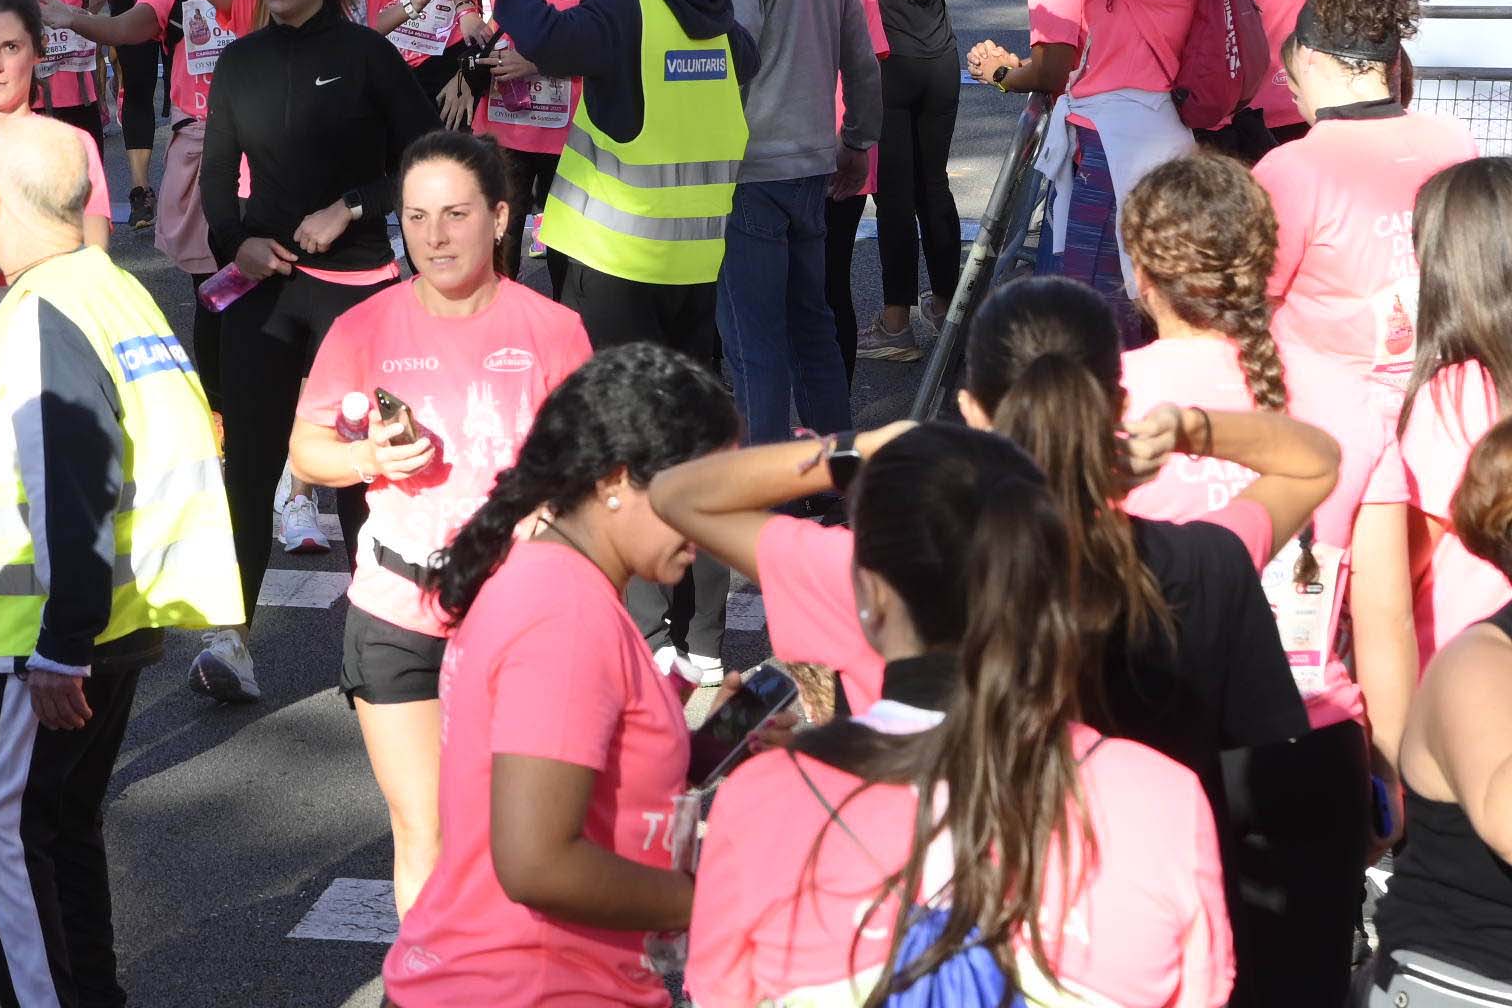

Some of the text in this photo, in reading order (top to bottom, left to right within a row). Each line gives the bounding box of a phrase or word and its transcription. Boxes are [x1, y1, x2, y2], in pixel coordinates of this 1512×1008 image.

[213, 27, 230, 37] 01
[195, 60, 216, 70] OYSH
[666, 56, 726, 73] VOLUNTARIS
[495, 112, 518, 120] OYSHO
[382, 356, 439, 373] OYSHO
